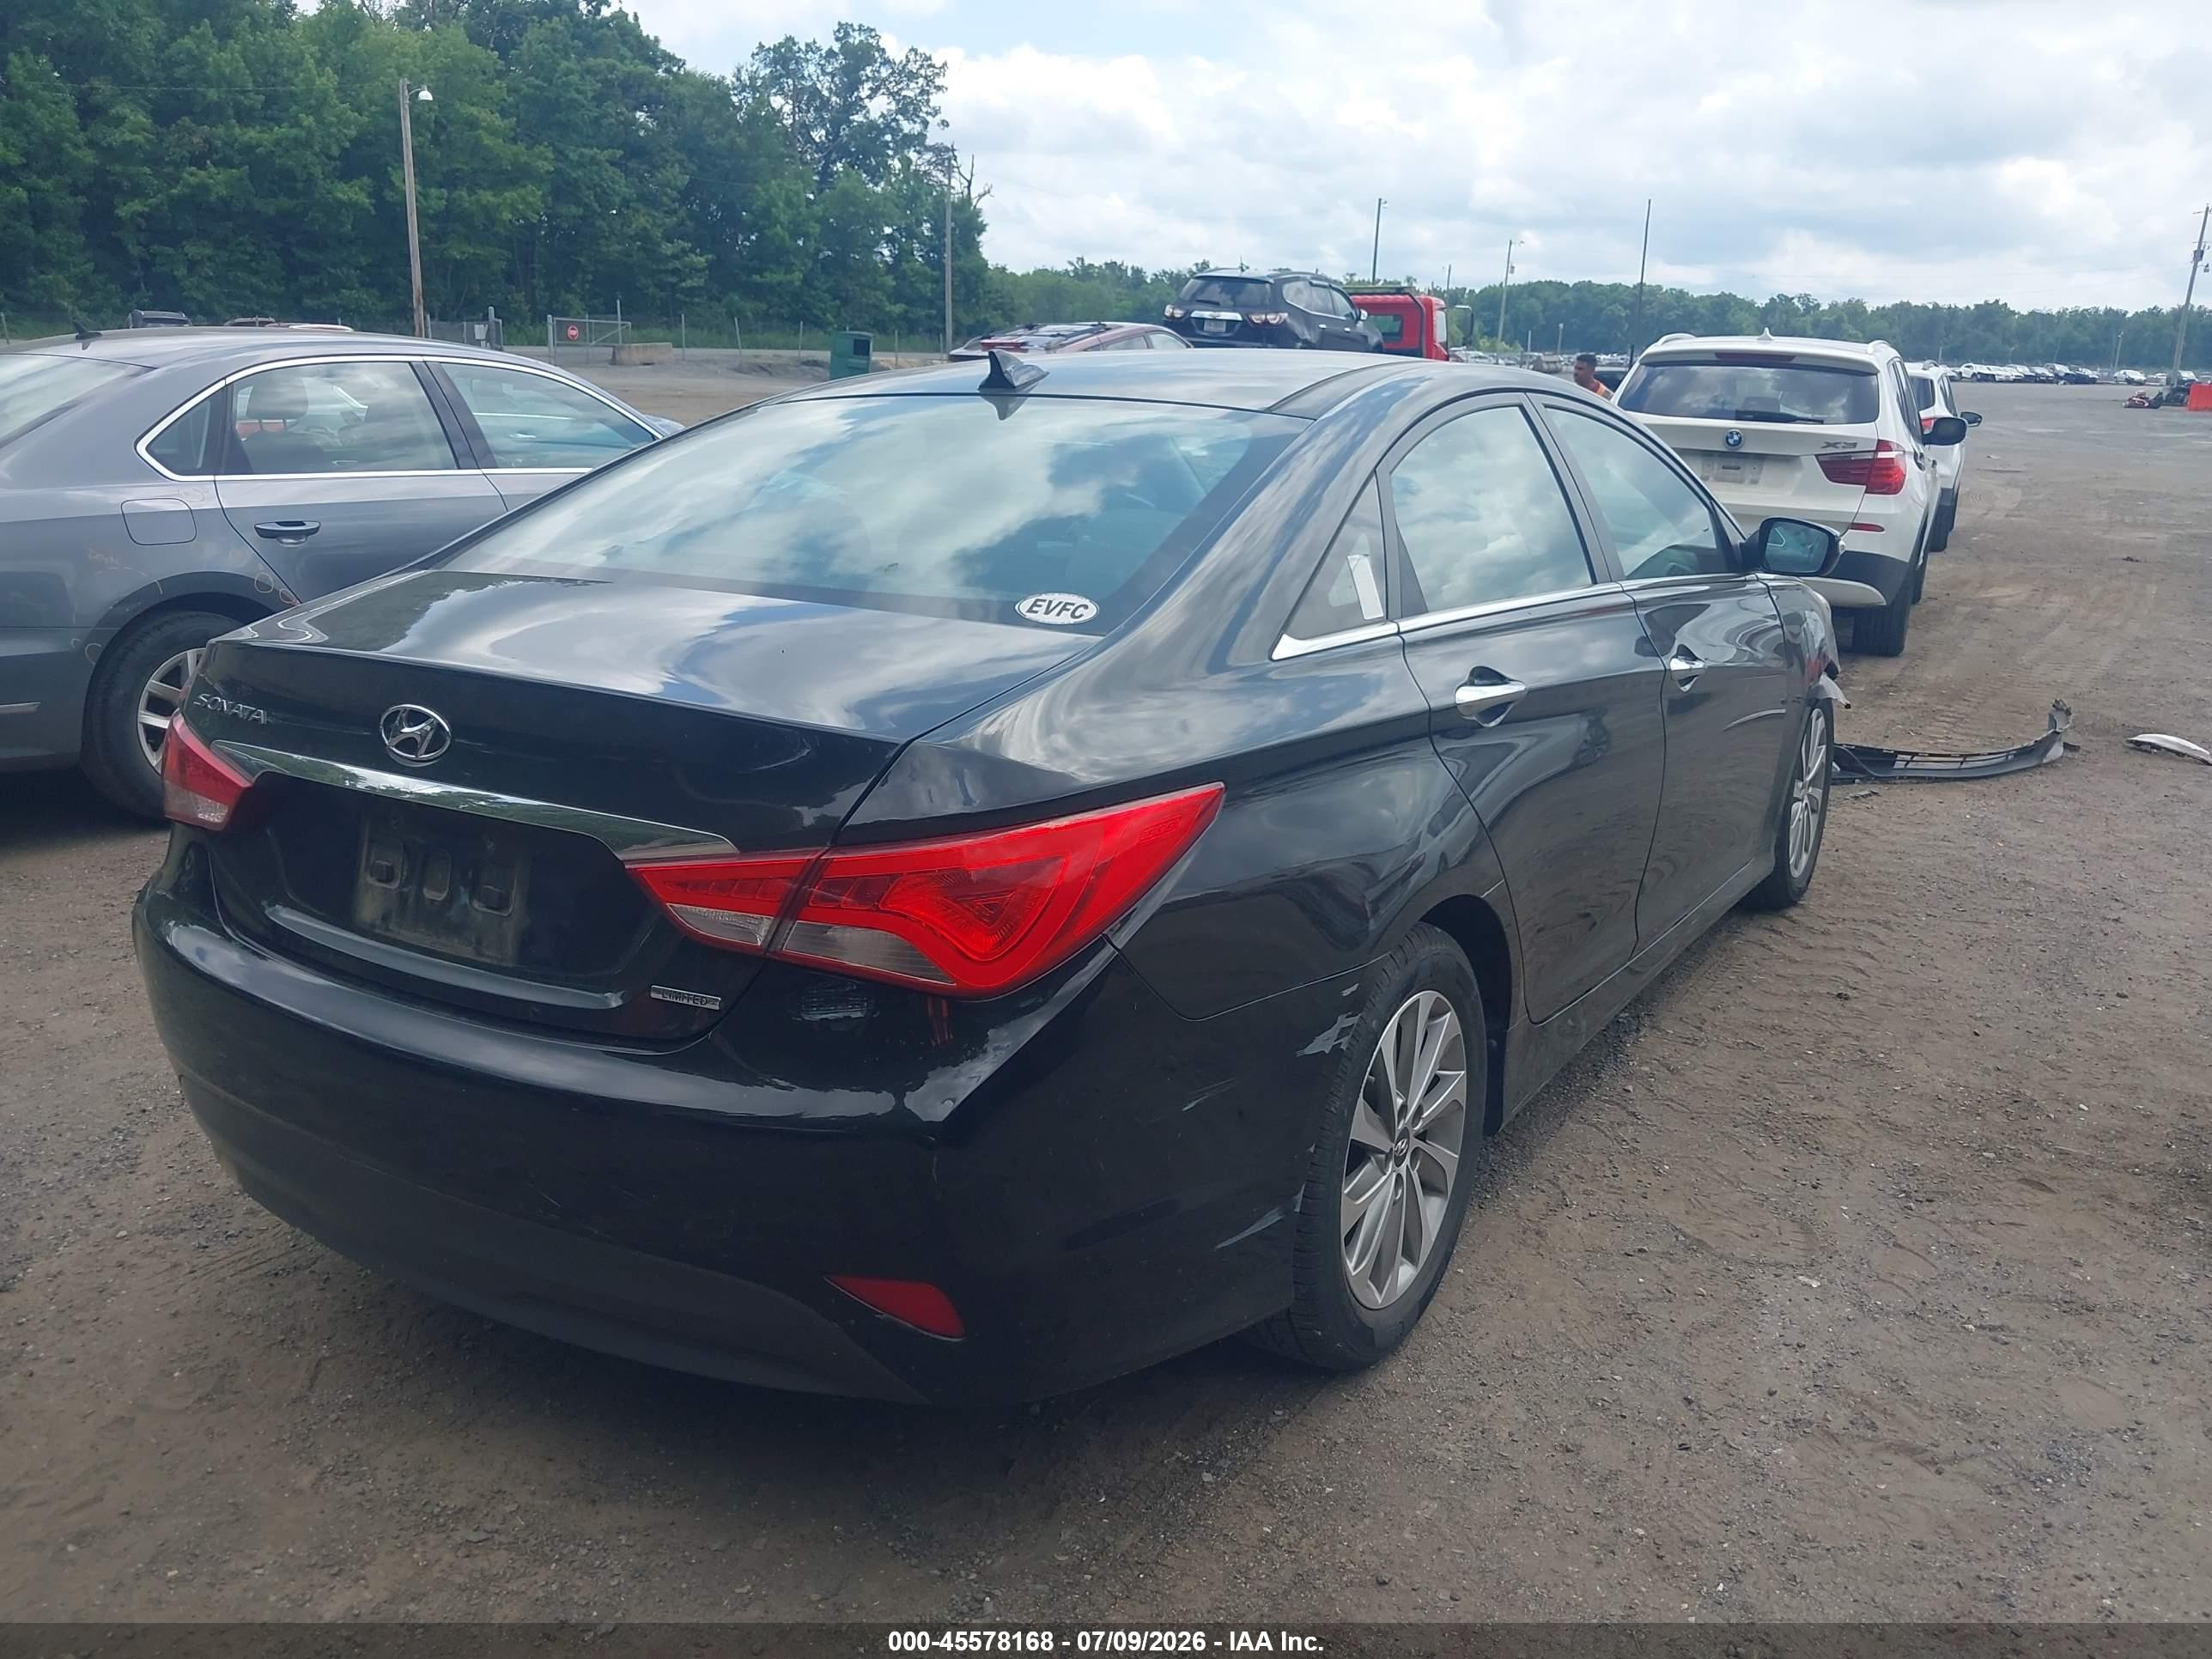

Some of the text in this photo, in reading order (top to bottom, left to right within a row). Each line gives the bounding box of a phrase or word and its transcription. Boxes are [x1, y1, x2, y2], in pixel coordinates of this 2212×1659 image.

[1025, 599, 1089, 619] EVFC
[193, 693, 267, 725] SONATA
[659, 989, 708, 1006] LIMITED
